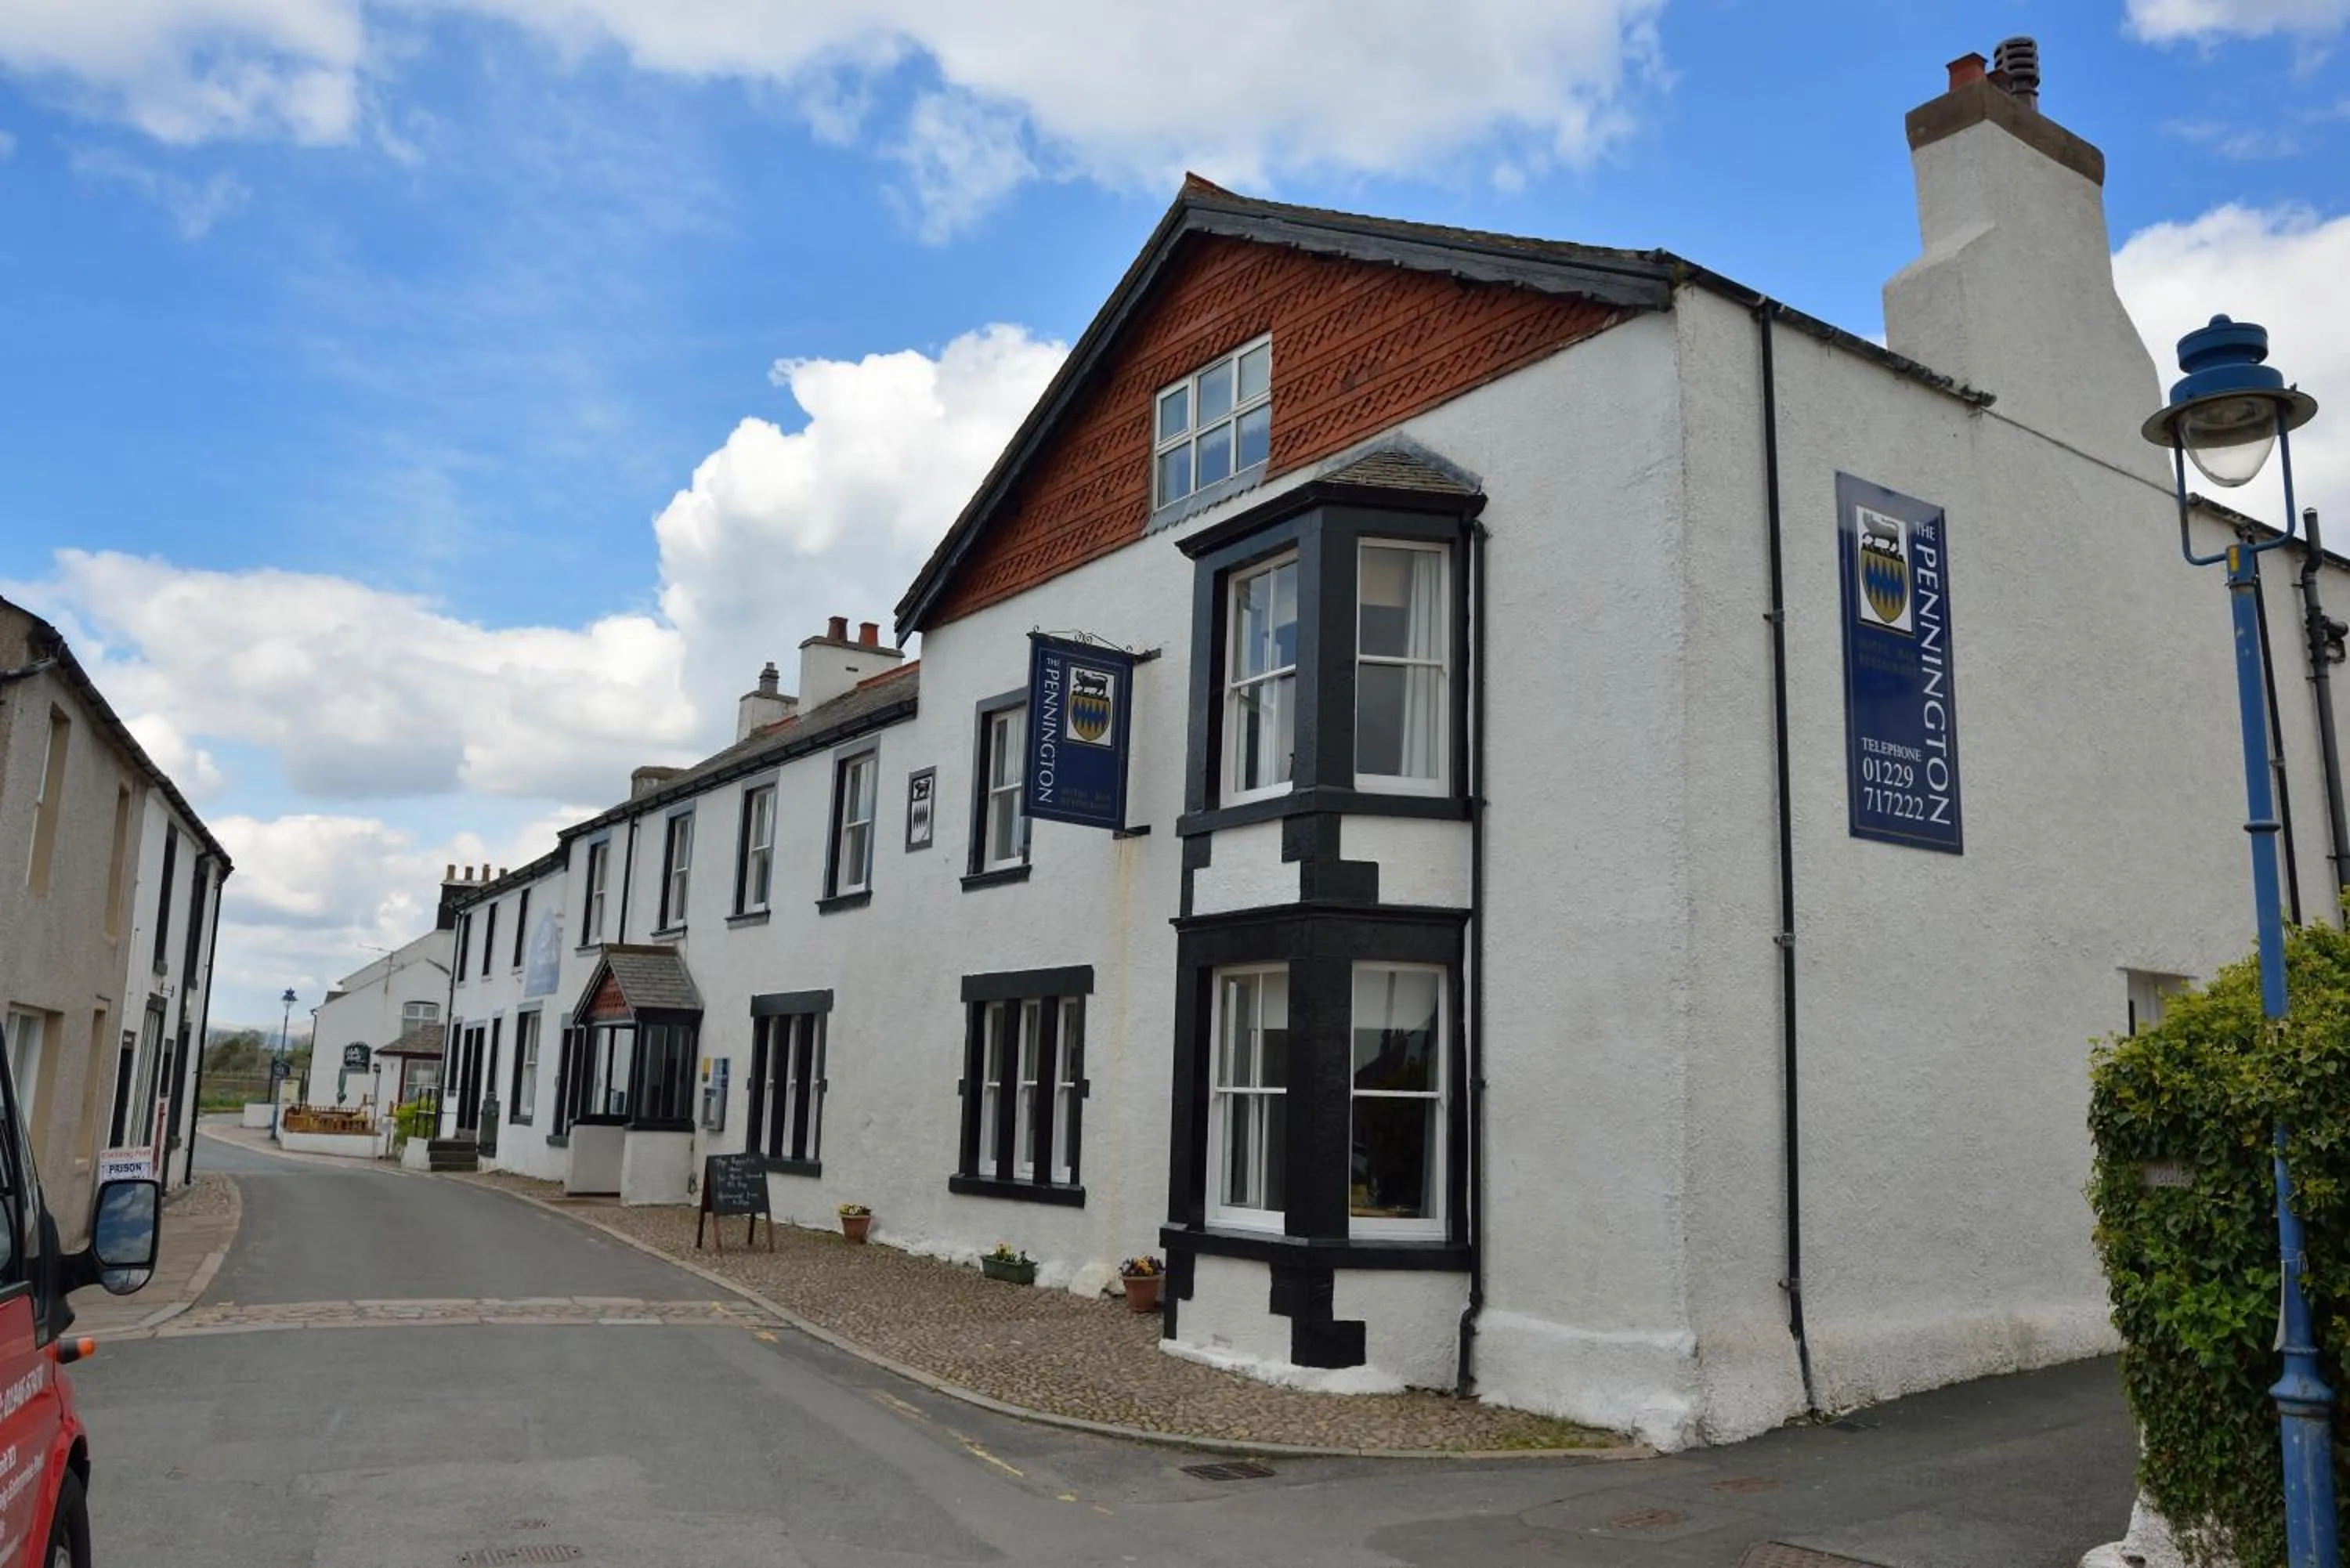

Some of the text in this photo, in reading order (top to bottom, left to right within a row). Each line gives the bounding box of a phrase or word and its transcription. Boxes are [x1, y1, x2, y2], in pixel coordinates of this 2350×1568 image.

[1914, 522, 1951, 825] THE PENNINGTON
[1039, 657, 1061, 803] THE PENNINGTON
[1861, 737, 1922, 762] TELEPHONE
[1863, 757, 1914, 789] 01229
[1864, 786, 1925, 821] 717222
[109, 1163, 142, 1174] PRISON
